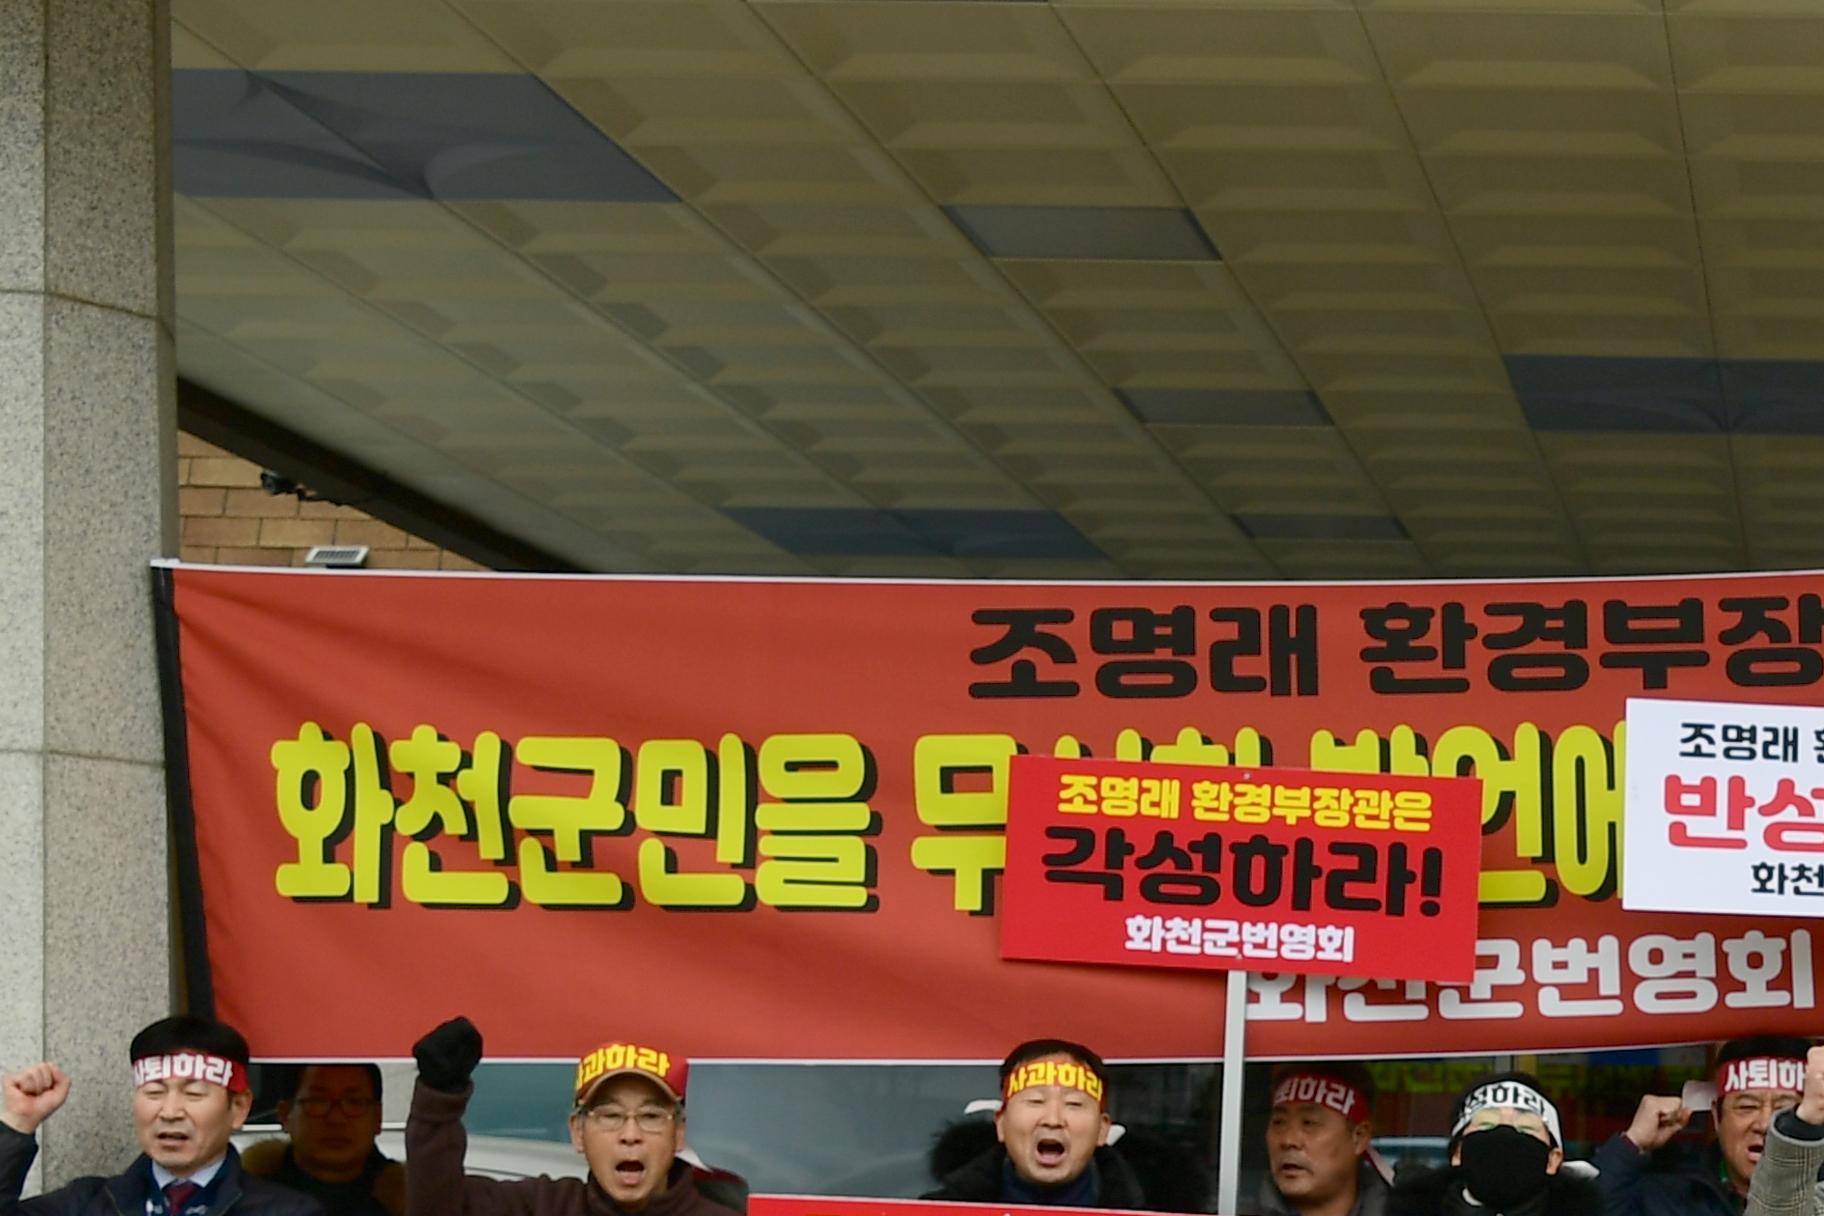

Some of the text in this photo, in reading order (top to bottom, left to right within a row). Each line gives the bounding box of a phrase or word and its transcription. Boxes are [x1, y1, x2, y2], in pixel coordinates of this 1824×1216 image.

[969, 602, 1320, 699] 조명래
[1678, 721, 1799, 764] 조명래
[271, 721, 878, 910] 화천군민을
[1056, 773, 1434, 833] 조명래 환경부장관은
[1040, 825, 1444, 918] 각성하라!
[1123, 914, 1356, 964] 화천군번영회
